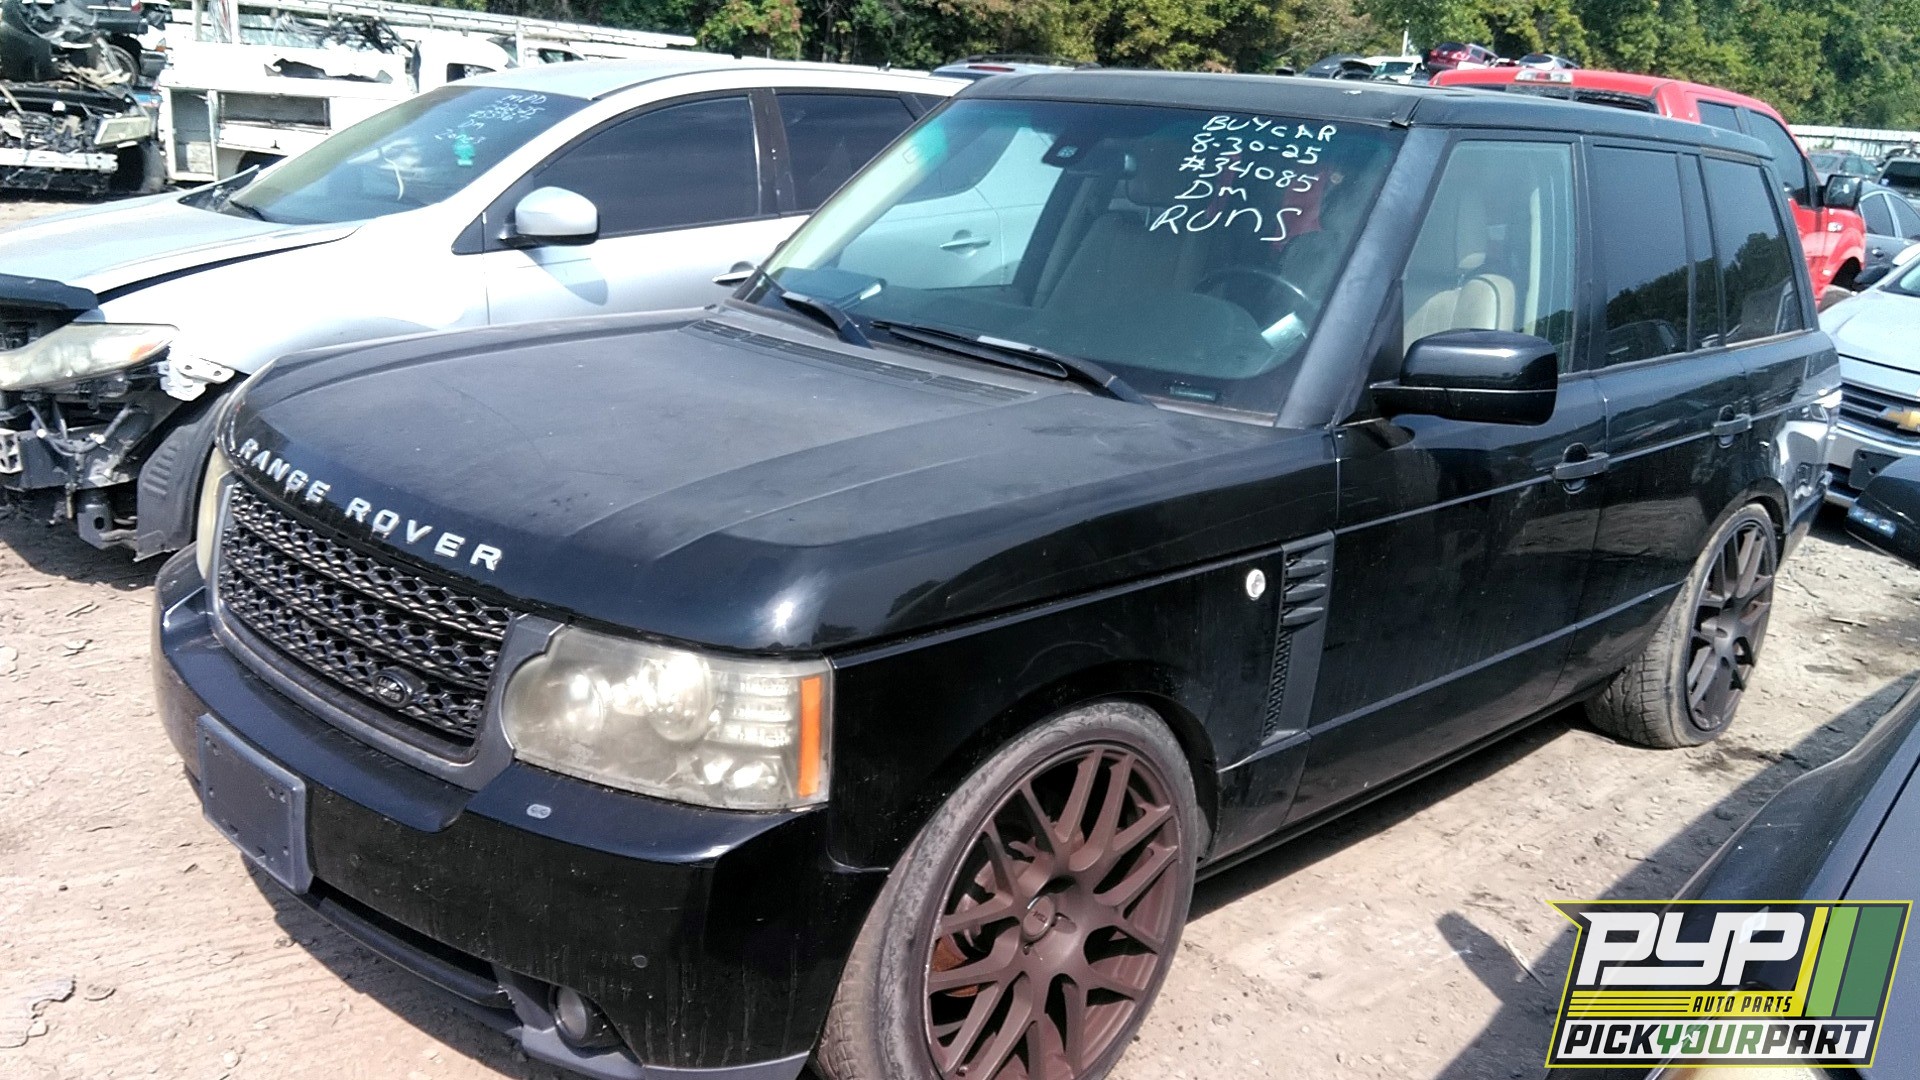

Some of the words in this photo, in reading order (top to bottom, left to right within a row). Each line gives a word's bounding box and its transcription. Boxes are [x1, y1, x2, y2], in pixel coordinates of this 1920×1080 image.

[1191, 132, 1322, 165] 8-30-25
[1178, 155, 1319, 193] #34085
[239, 438, 331, 503] RANGE
[345, 497, 503, 571] ROVER
